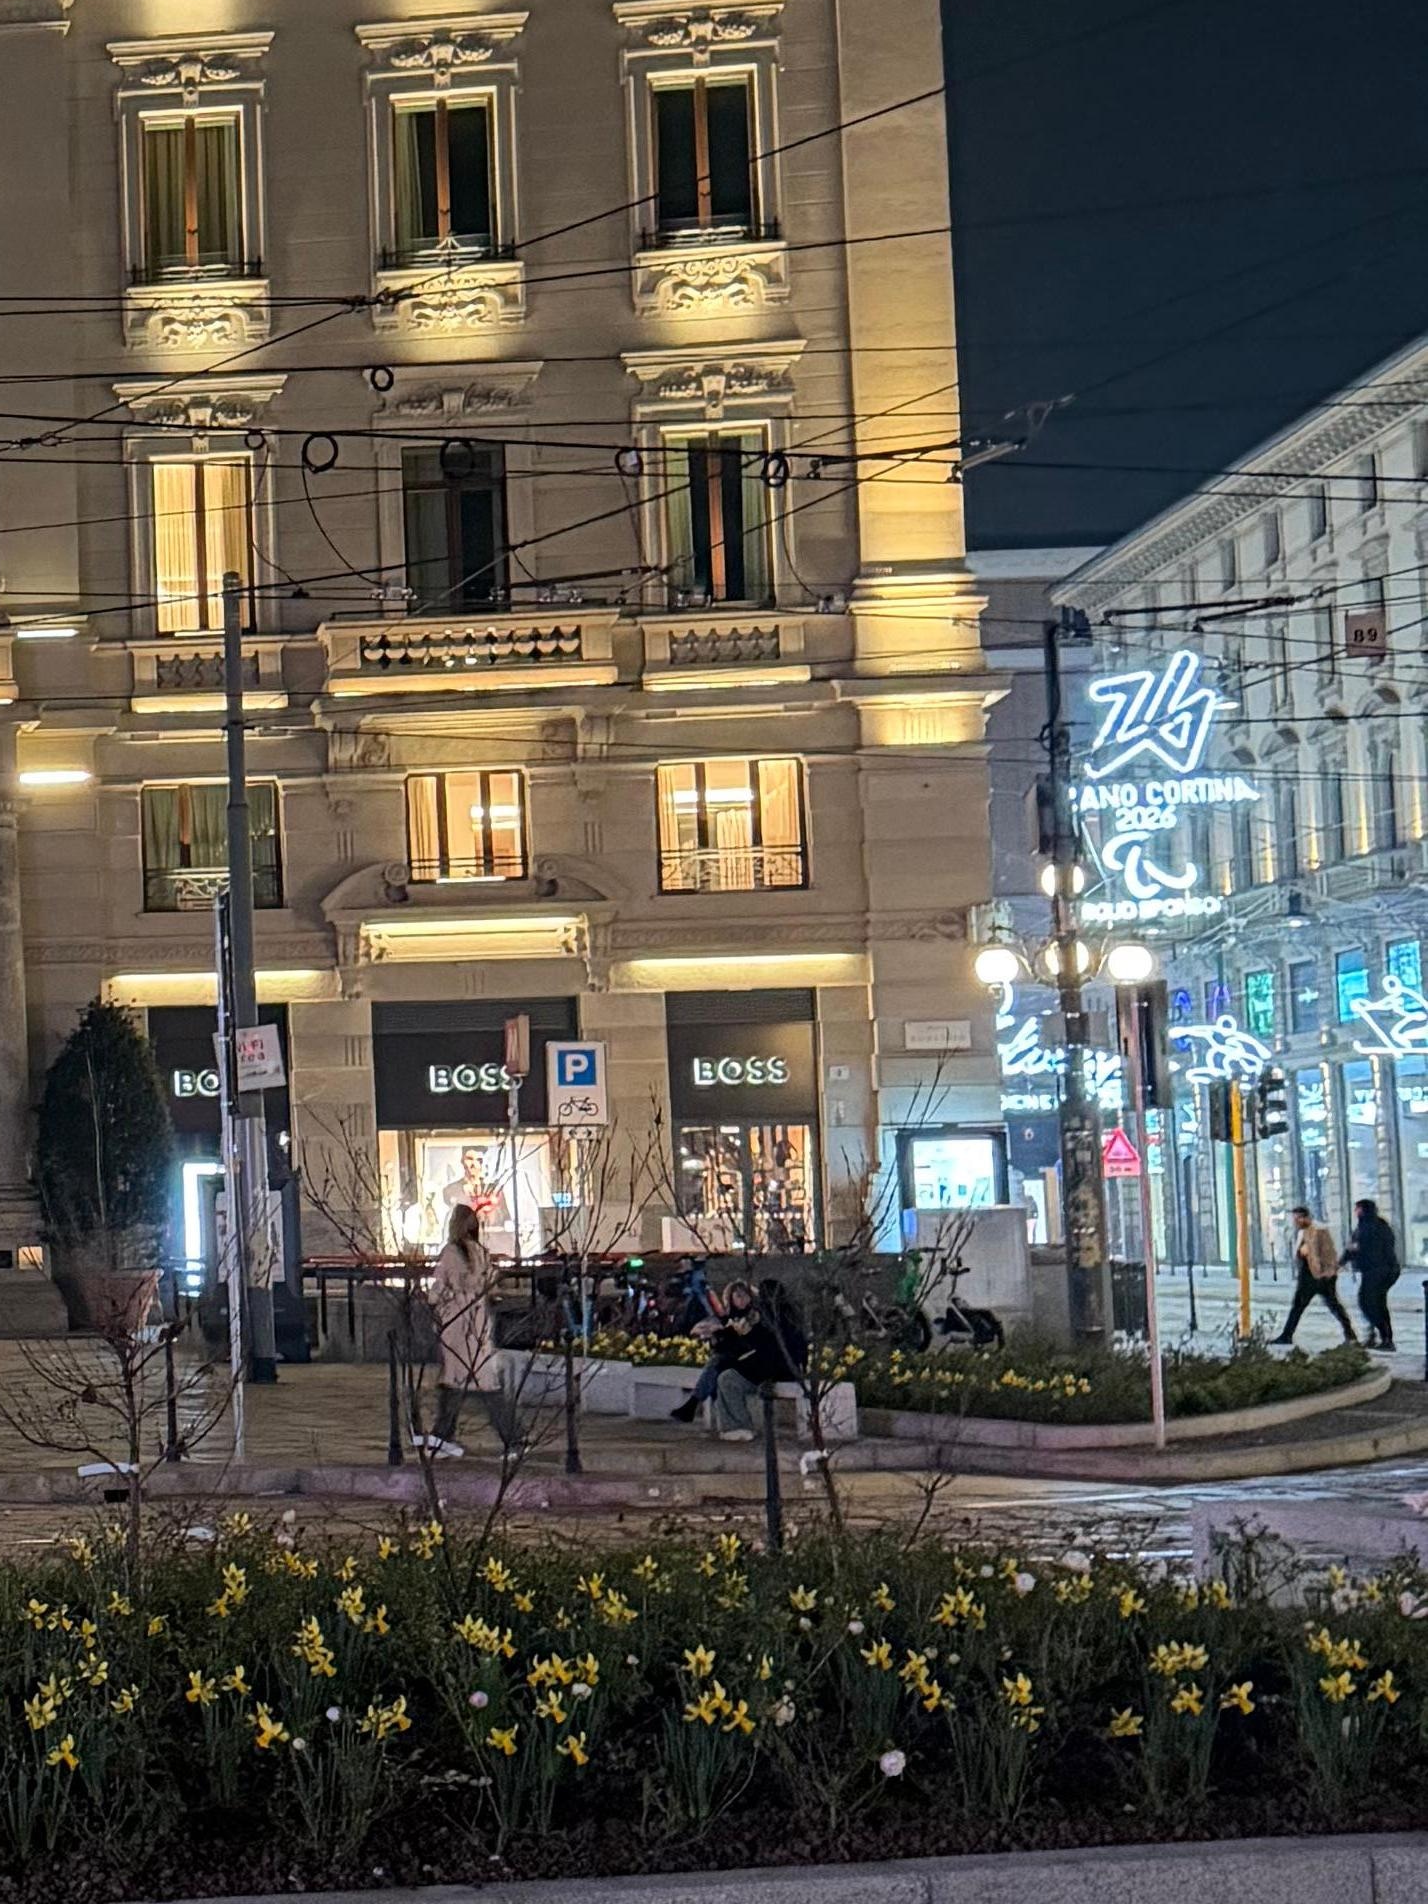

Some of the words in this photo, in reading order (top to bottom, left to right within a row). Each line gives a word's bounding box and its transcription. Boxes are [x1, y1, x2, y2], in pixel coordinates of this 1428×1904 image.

[1146, 776, 1259, 806] CORTINA
[1115, 805, 1177, 832] 2026
[173, 1068, 221, 1097] BO
[565, 1054, 589, 1082] P
[693, 1056, 791, 1086] BOSS
